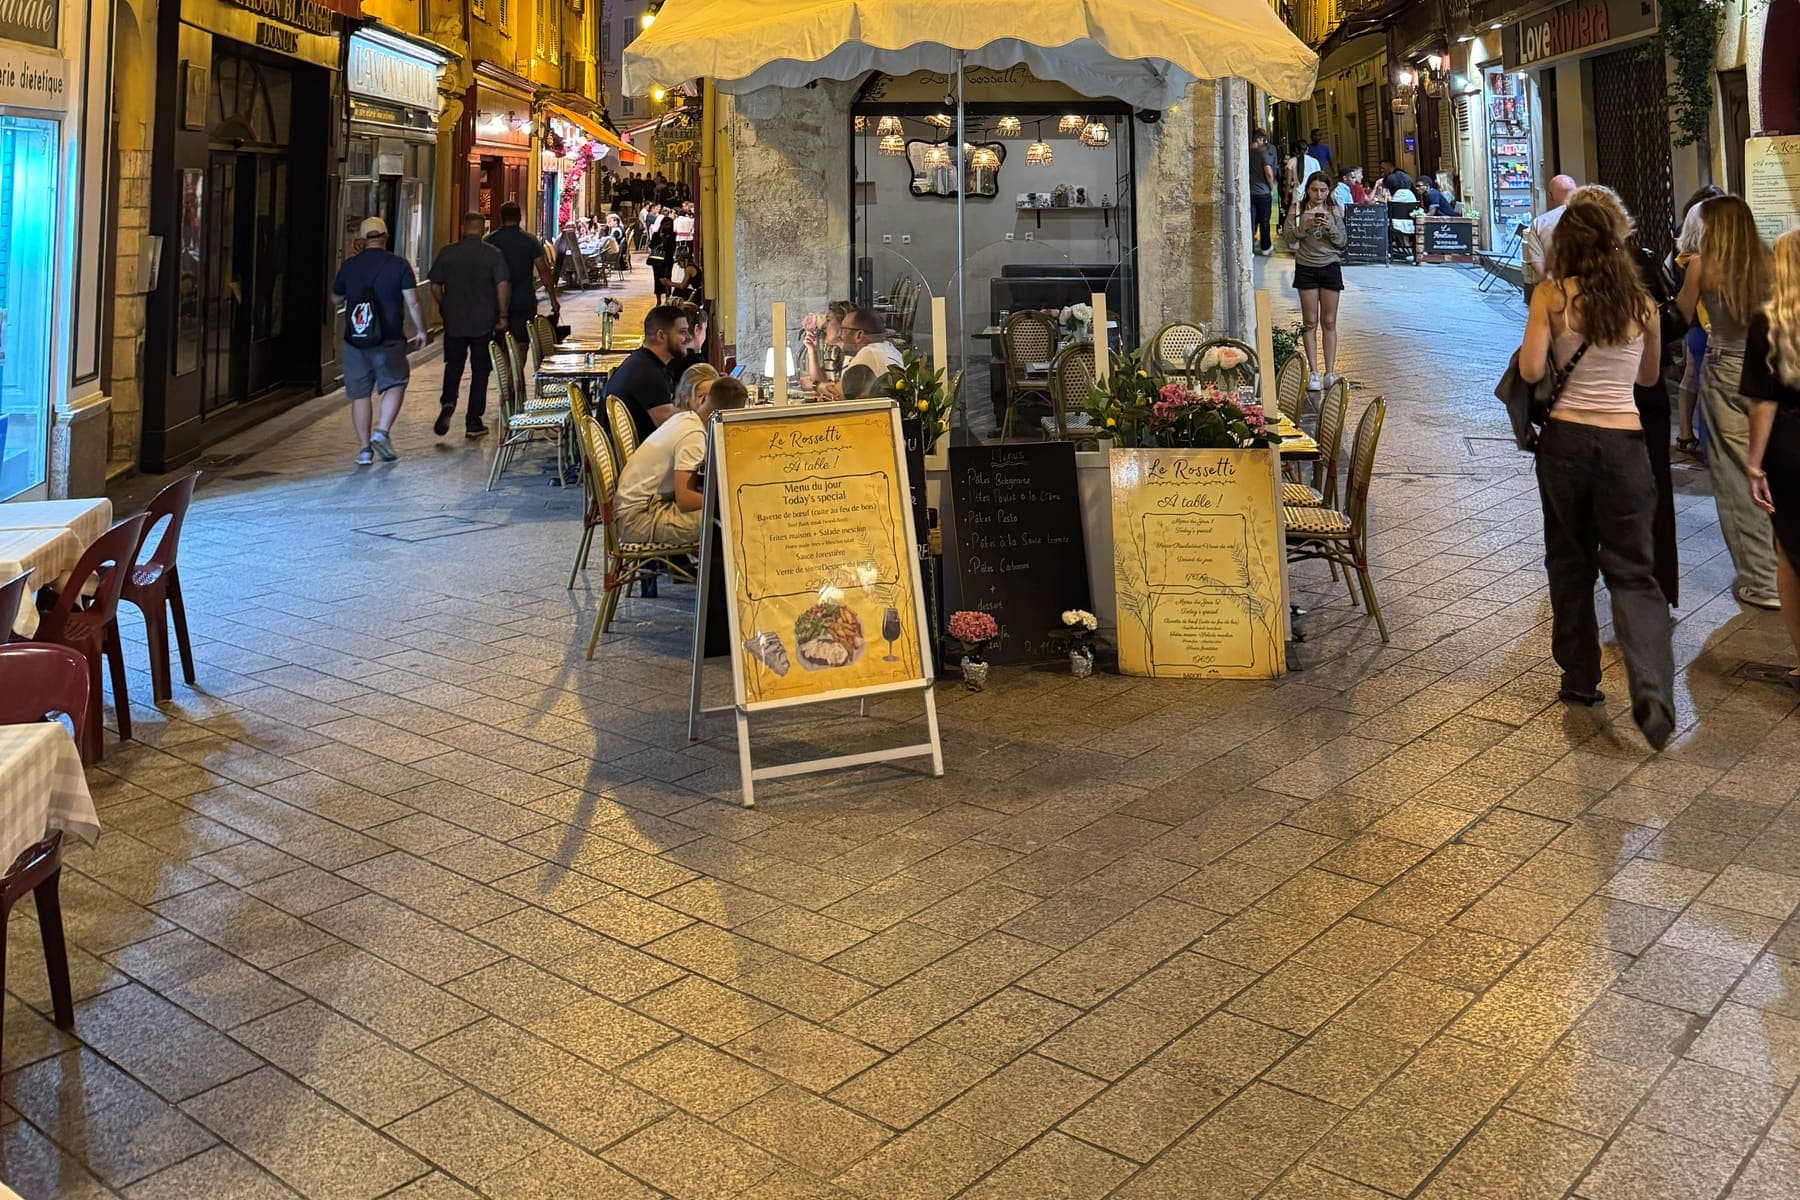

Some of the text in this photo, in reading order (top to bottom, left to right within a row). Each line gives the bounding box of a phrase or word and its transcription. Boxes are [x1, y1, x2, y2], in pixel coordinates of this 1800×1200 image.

[263, 23, 299, 53] DONUTS
[666, 140, 695, 158] POP
[769, 425, 842, 449] Le Rossetti
[804, 456, 830, 471] table
[1148, 457, 1236, 480] Le Rossetti
[784, 480, 842, 494] Menu du jour
[782, 490, 846, 506] Today's special
[1181, 493, 1213, 508] table
[783, 511, 793, 519] de
[839, 506, 850, 514] feu
[769, 533, 787, 543] Frites
[819, 527, 841, 537] Salade
[796, 552, 815, 561] Sauce
[775, 567, 794, 576] Verre
